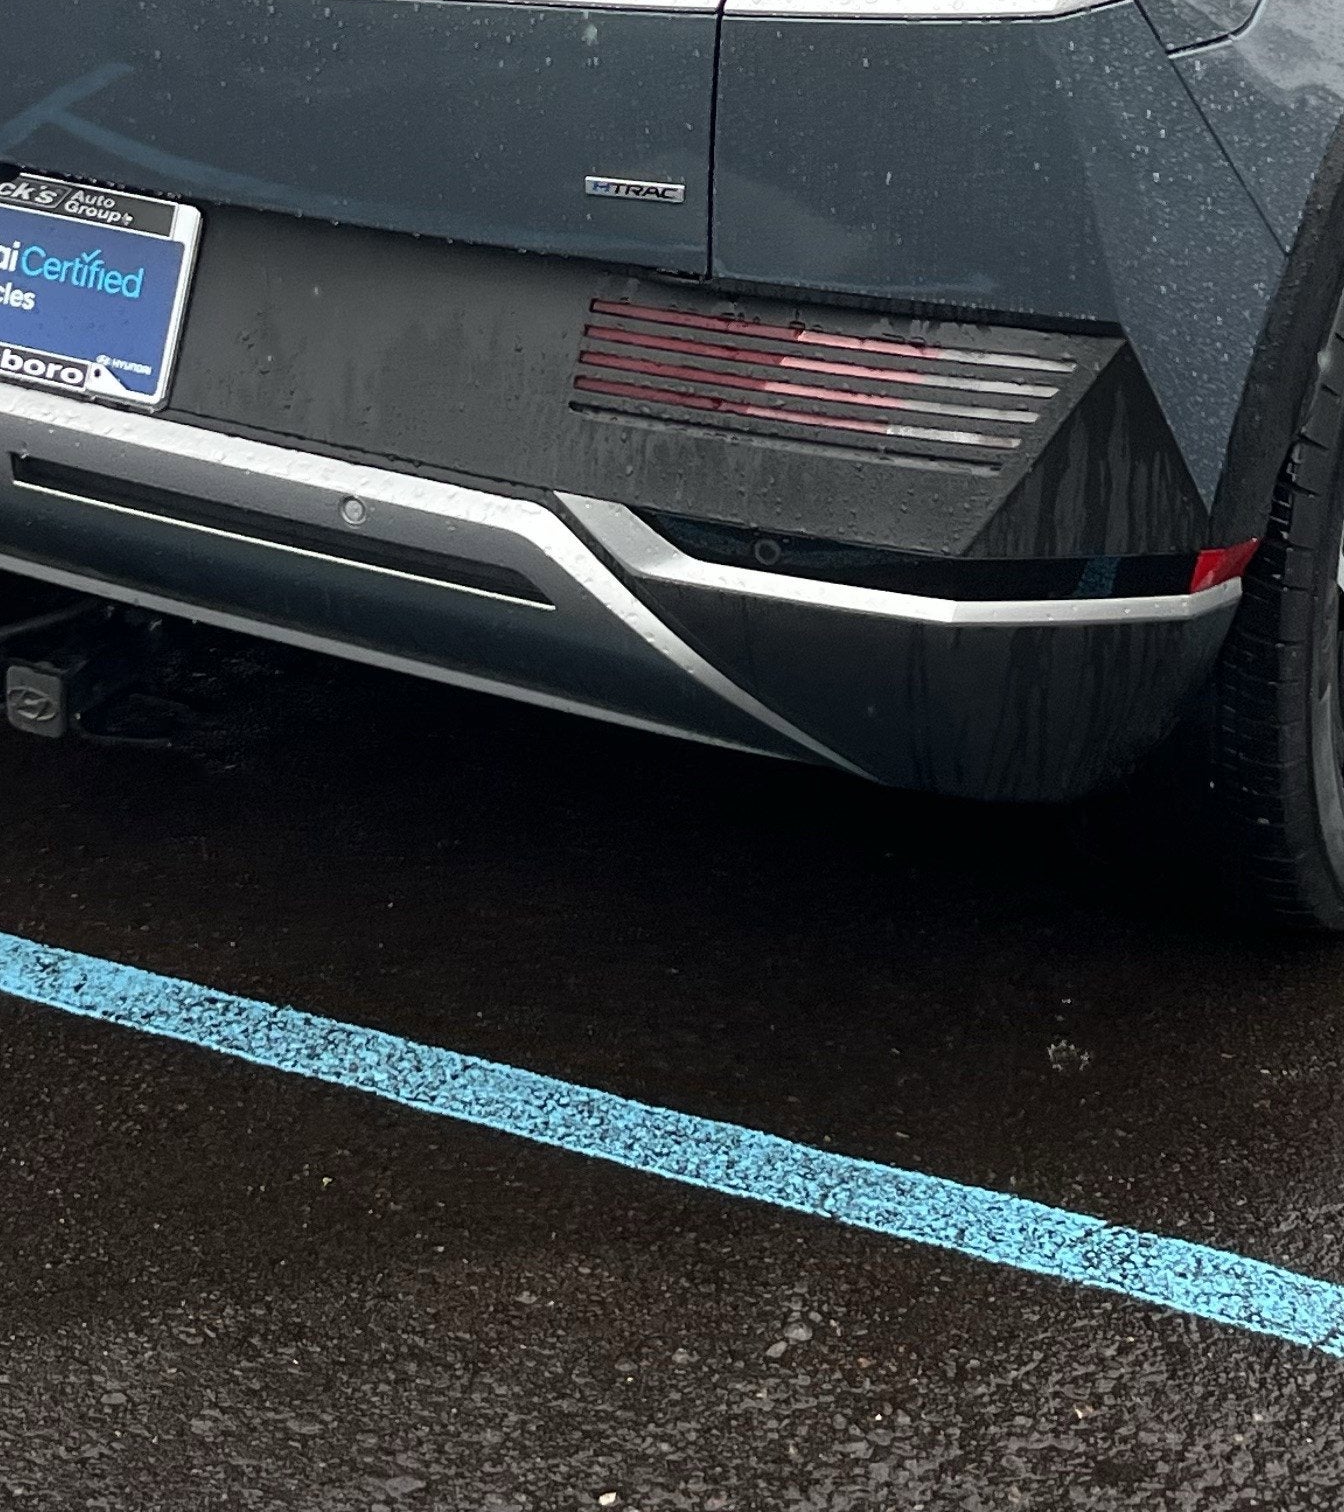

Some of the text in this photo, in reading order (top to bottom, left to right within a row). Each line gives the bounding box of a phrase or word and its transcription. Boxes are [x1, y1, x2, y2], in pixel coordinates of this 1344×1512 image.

[71, 189, 116, 208] Auto
[592, 180, 679, 199] HTRAC
[64, 199, 122, 224] Group
[21, 246, 144, 298] Certified
